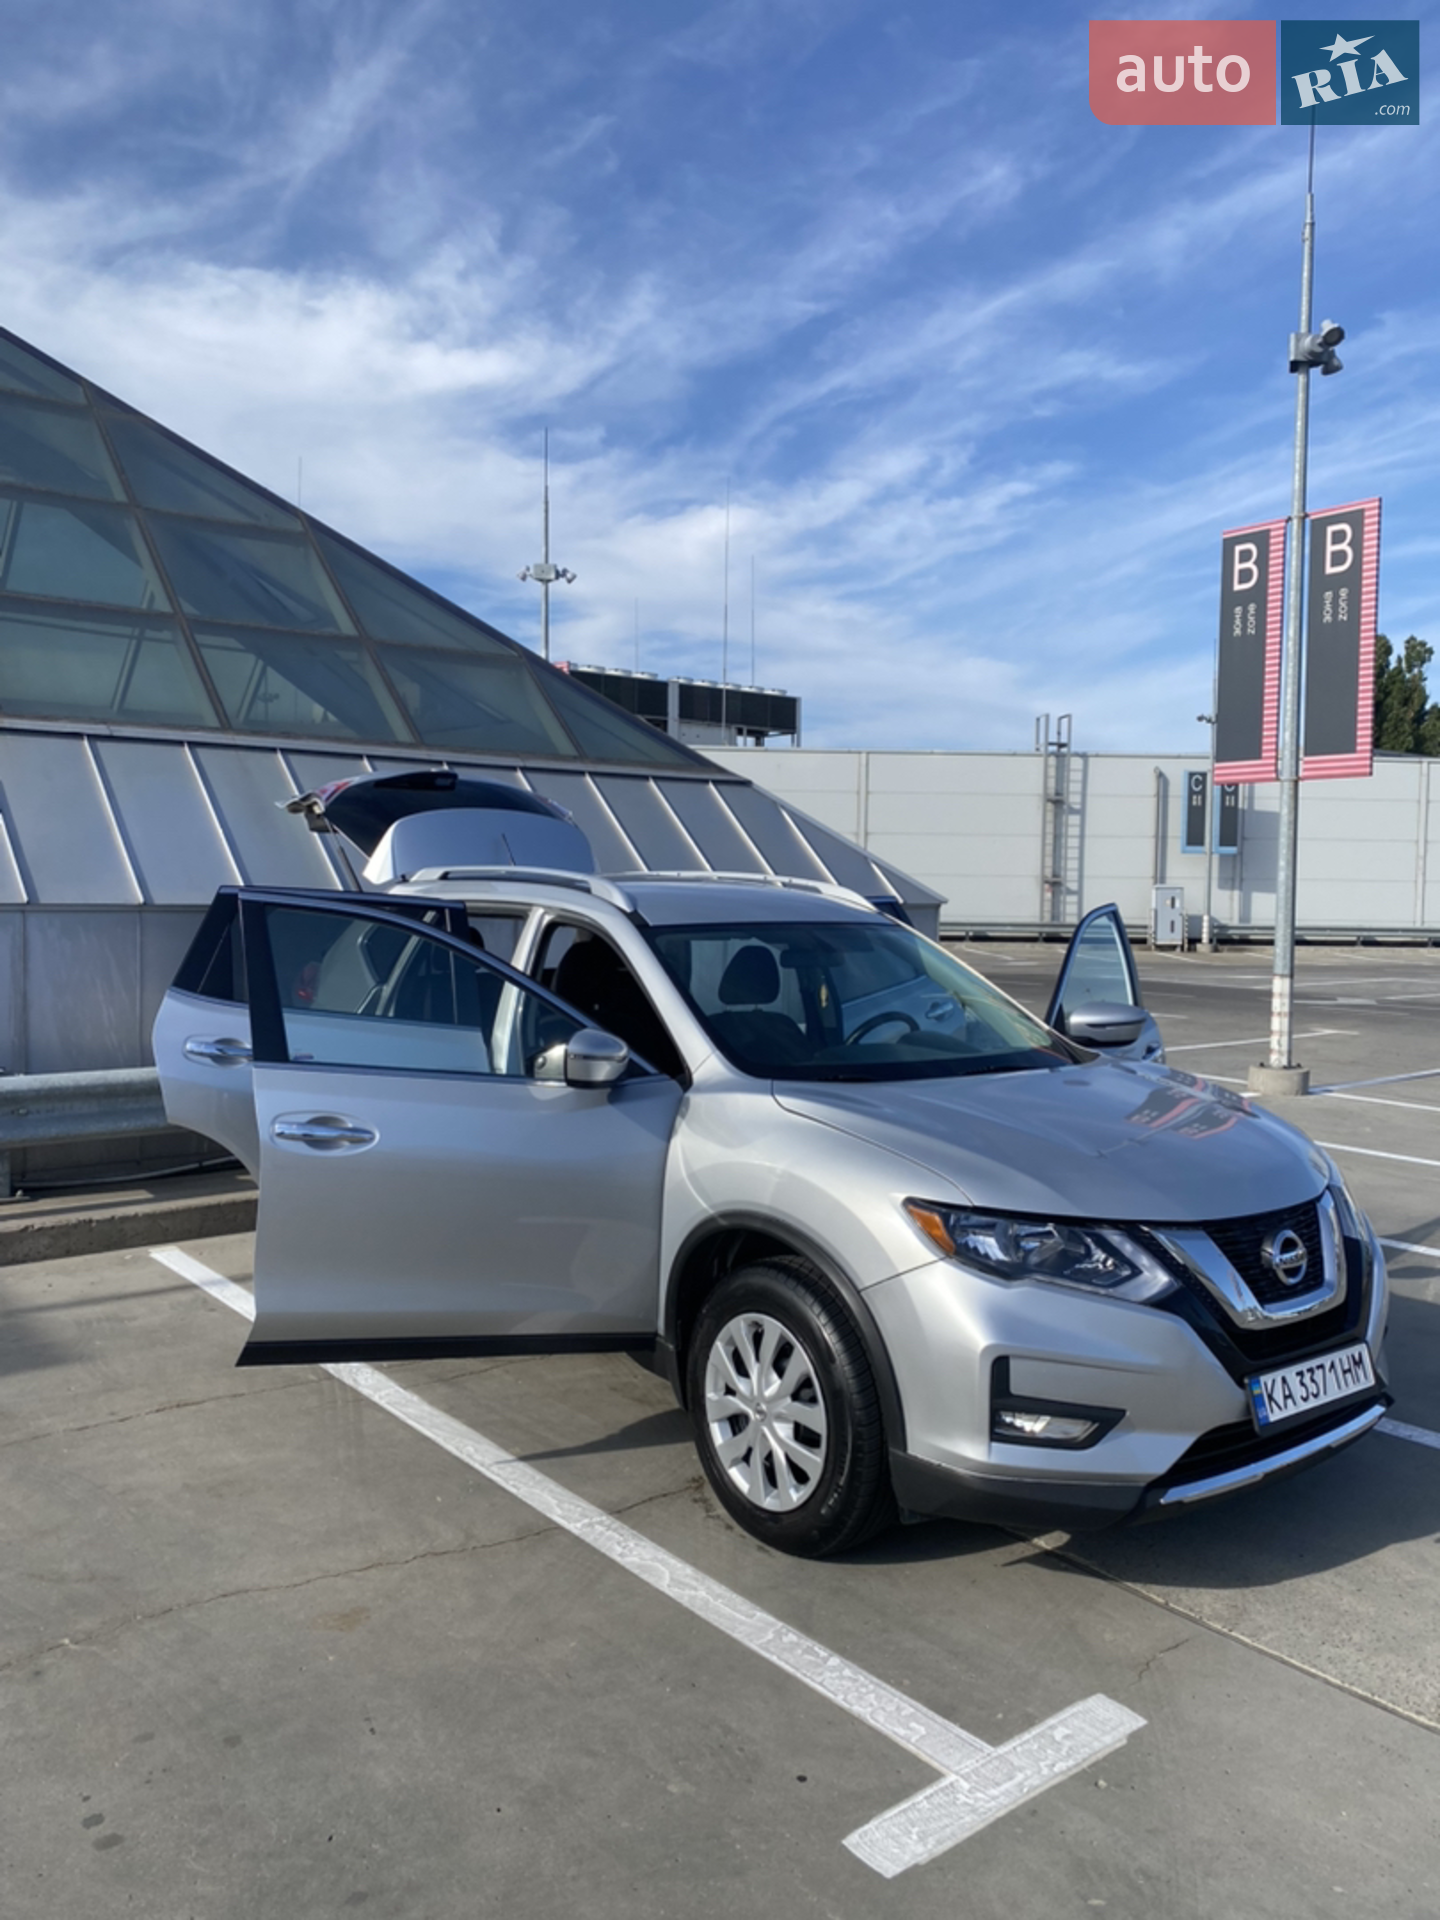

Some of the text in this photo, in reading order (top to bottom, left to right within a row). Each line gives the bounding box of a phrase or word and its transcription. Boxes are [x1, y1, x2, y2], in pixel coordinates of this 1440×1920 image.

[1233, 542, 1259, 592] B
[1325, 523, 1353, 575] B
[1191, 774, 1203, 792] C
